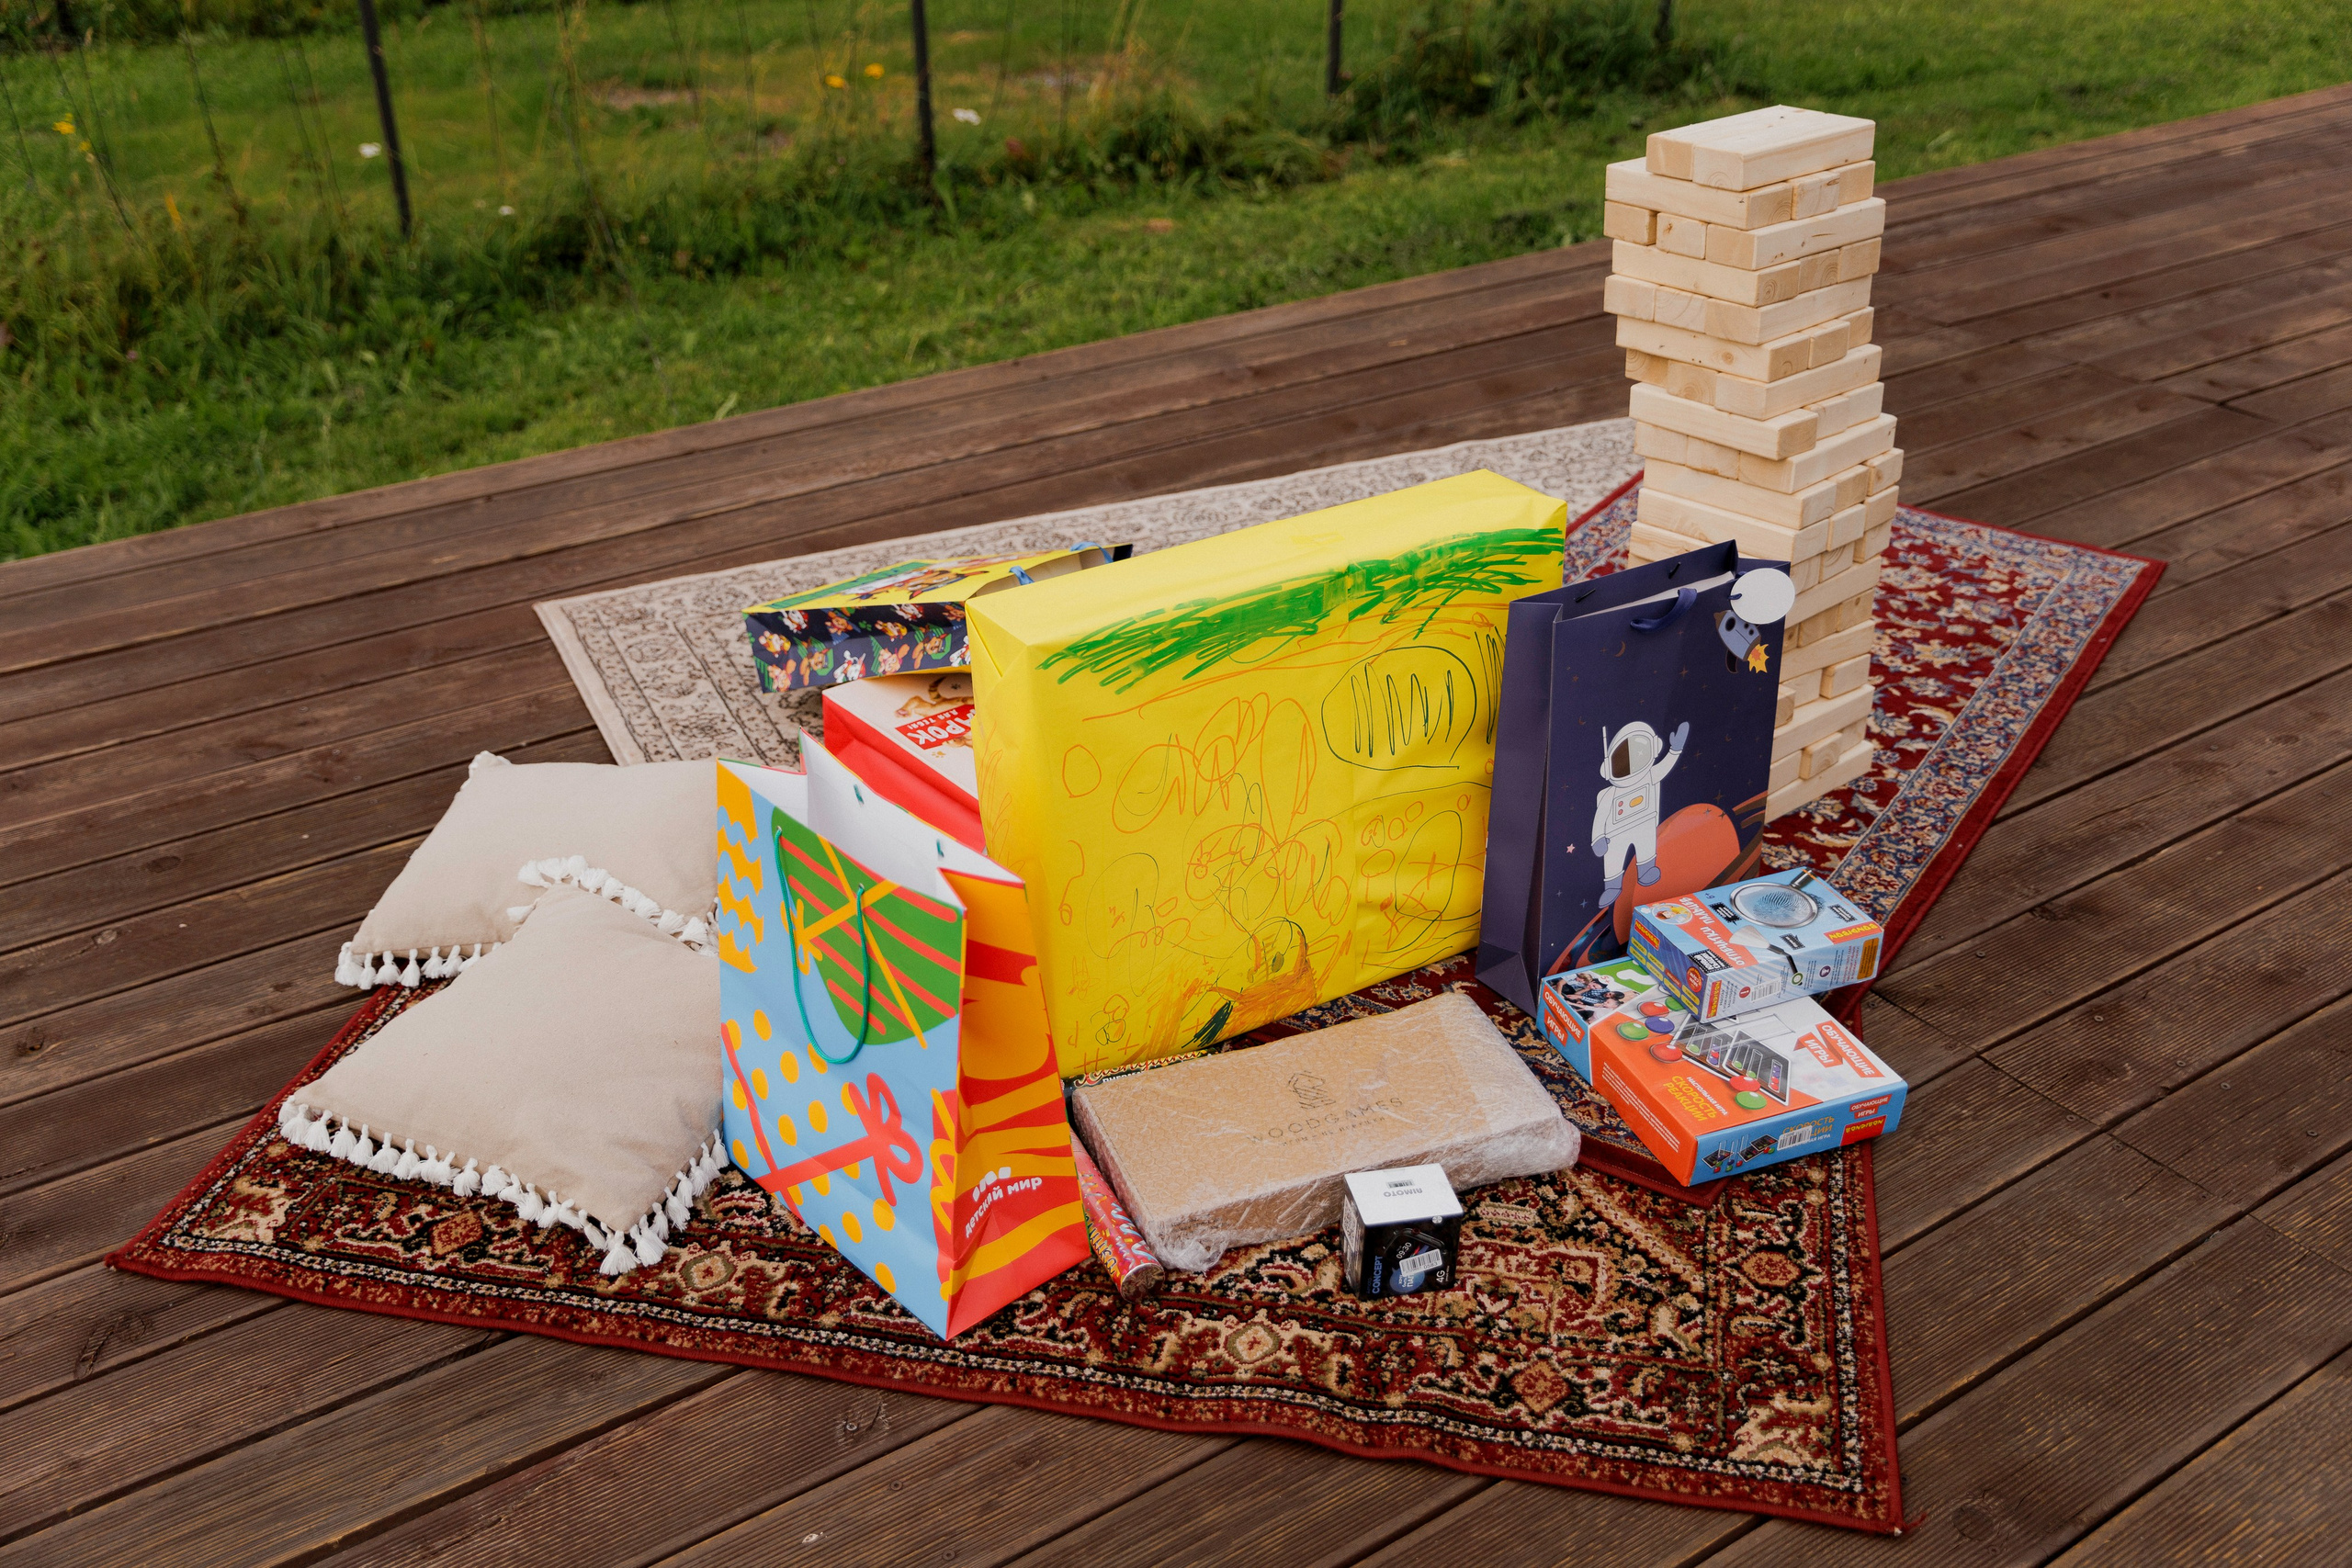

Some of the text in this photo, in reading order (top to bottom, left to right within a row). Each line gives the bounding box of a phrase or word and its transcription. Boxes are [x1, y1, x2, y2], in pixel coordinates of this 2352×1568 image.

[1679, 897, 1714, 924] ПАЛЬЦЕВ
[1828, 923, 1879, 940] BONDIBON
[1700, 926, 1746, 966] ОТПЕЧАТКИ
[1544, 991, 1581, 1039] ОБУЧАЮЩИЕ
[1546, 1016, 1565, 1042] ИГРЫ
[1804, 1039, 1835, 1064] ИГРЫ
[1822, 1024, 1875, 1076] ОБУЧАЮЩИЕ
[1663, 1082, 1708, 1122] РЕАКЦИИ
[1671, 1075, 1718, 1119] СКОРОСТЬ
[1686, 1076, 1728, 1116] НАСТОЛЬНАЯ ИГРА
[1851, 1097, 1888, 1111] ОБУЧАЮЩИЕ
[1845, 1118, 1883, 1134] BONDIBON
[1858, 1109, 1875, 1118] ИГРЫ
[1383, 1187, 1423, 1198] AIMOTO
[965, 1177, 1043, 1238] детский мир
[1396, 1242, 1412, 1259] 09:30
[1372, 1255, 1383, 1294] CONCEPT
[1436, 1269, 1446, 1283] 4G
